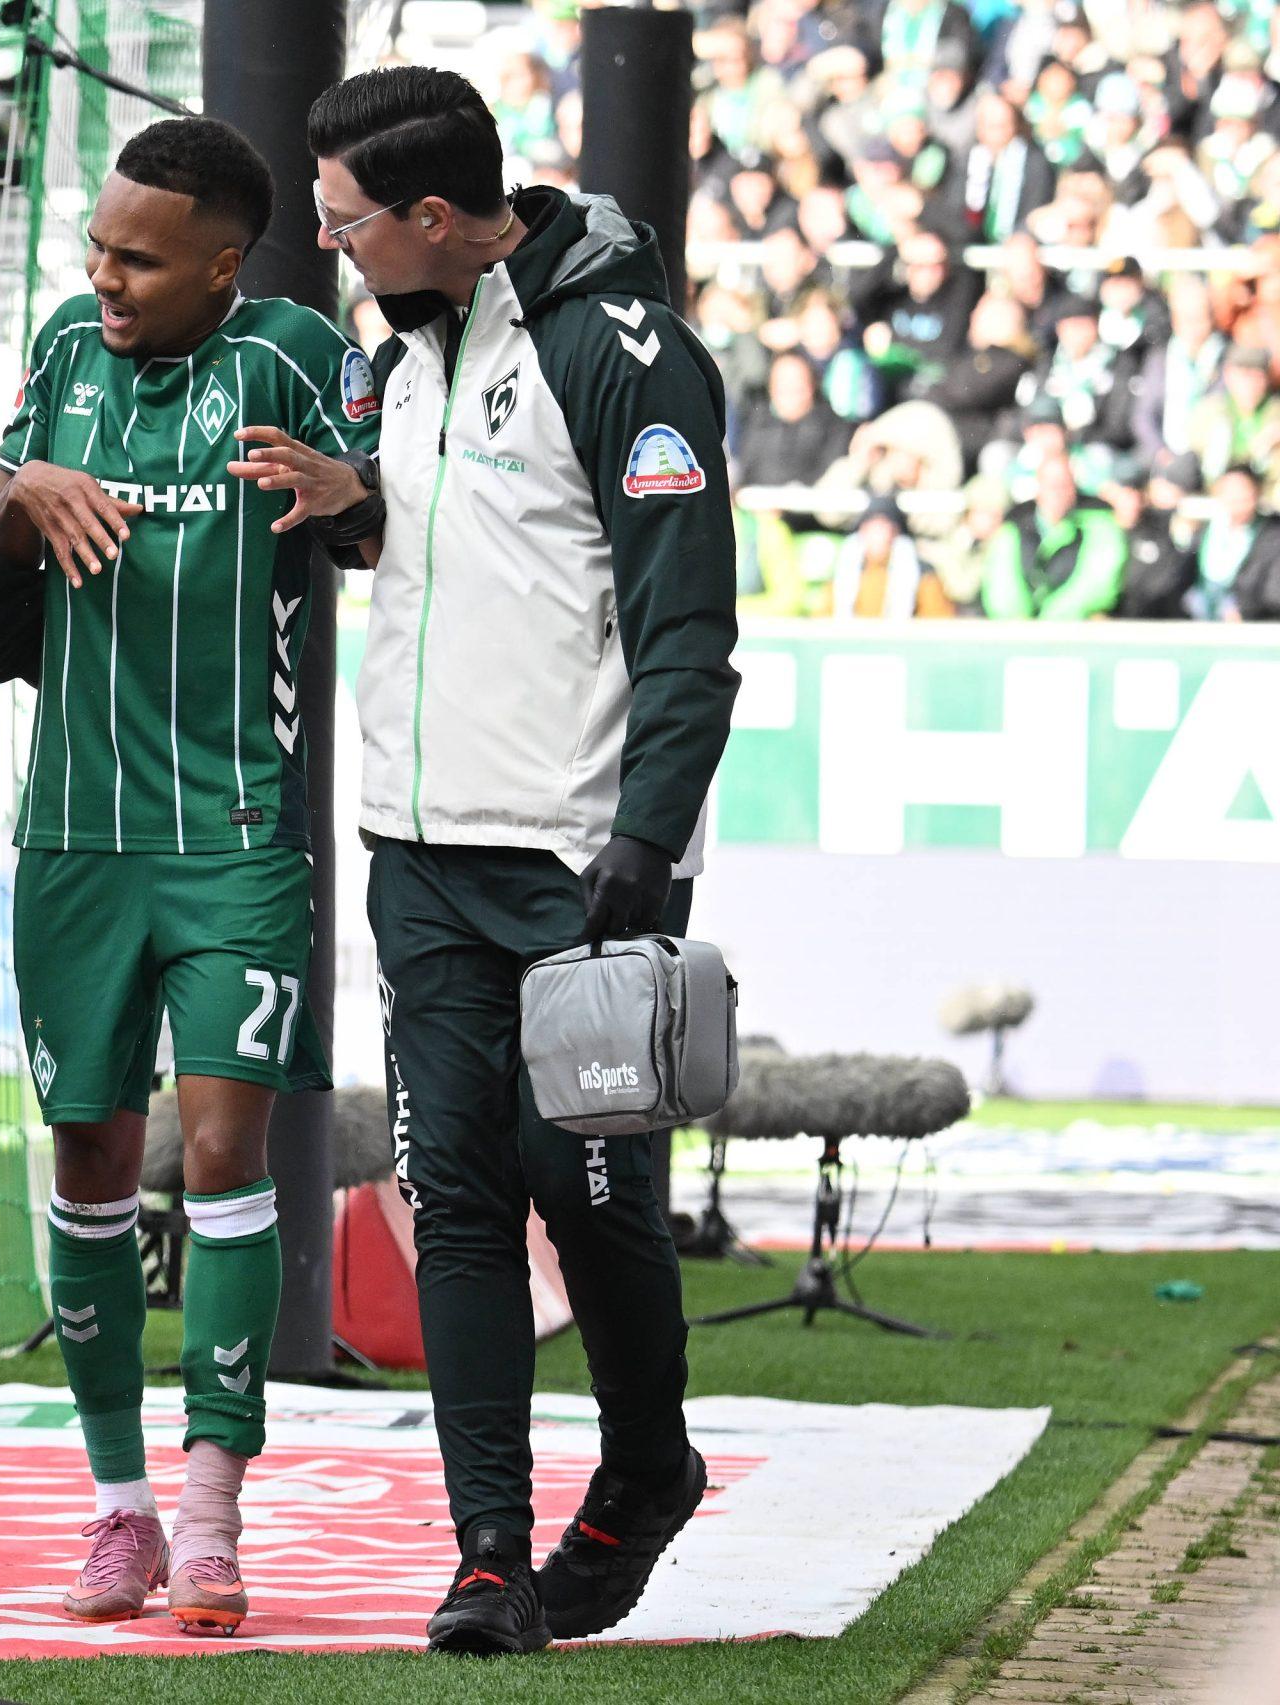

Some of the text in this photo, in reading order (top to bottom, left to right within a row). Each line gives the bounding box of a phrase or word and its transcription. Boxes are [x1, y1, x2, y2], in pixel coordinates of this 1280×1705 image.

[351, 400, 380, 416] Ammer
[95, 478, 226, 512] TTHÄI
[629, 475, 699, 490] Ammerländer
[236, 968, 300, 1065] 27
[578, 1061, 639, 1096] inSports
[389, 1053, 423, 1208] MATTH
[585, 1135, 611, 1206] HÄI
